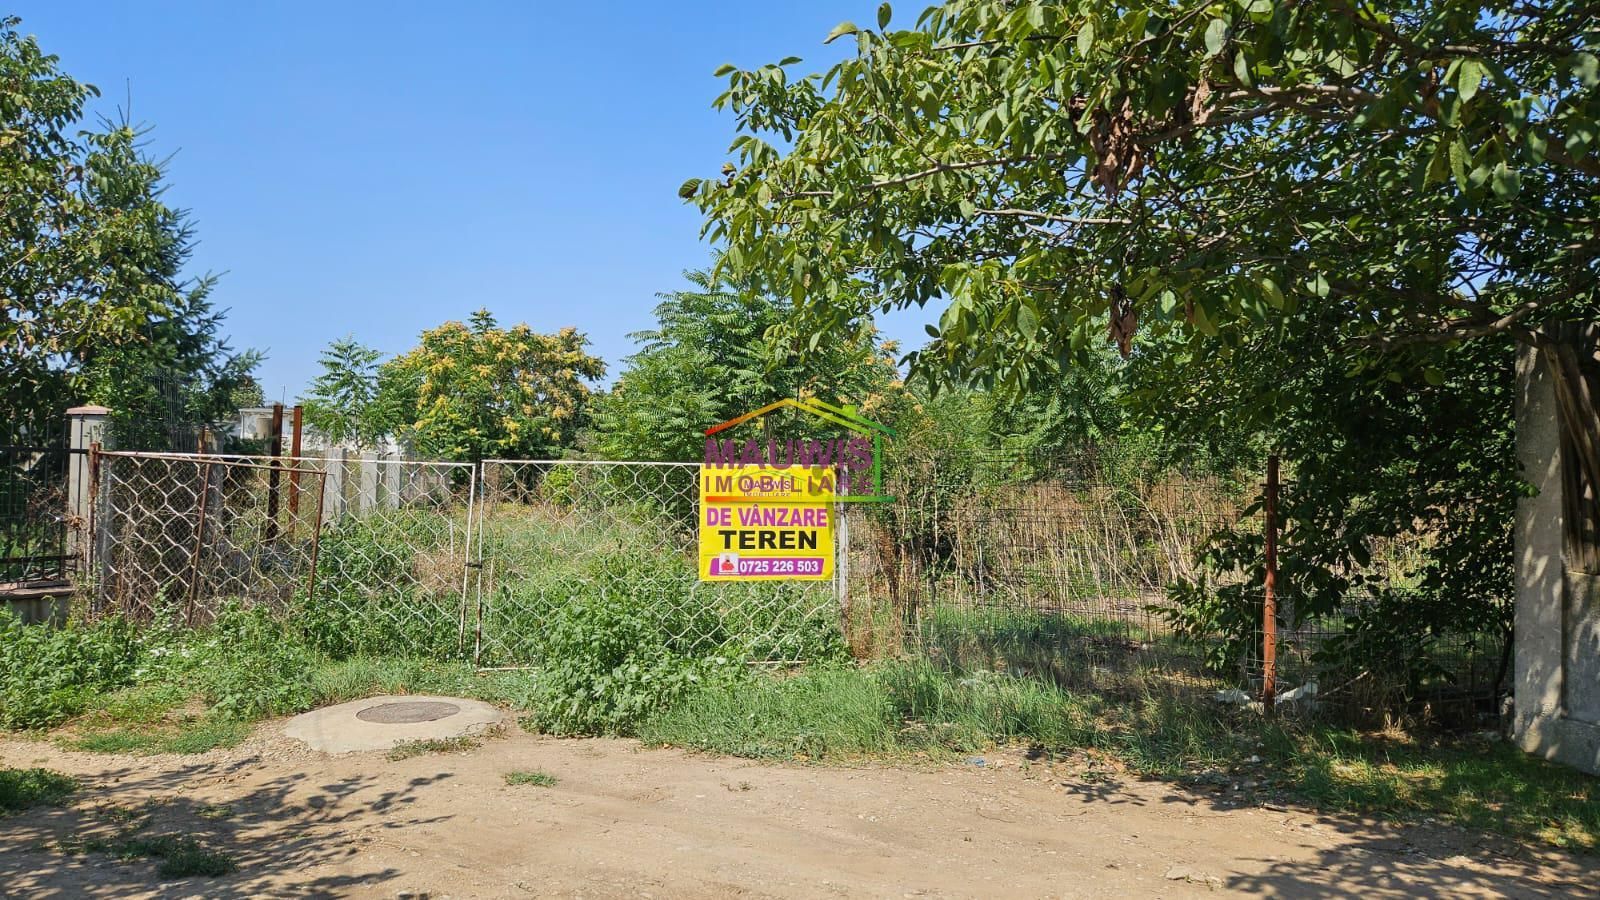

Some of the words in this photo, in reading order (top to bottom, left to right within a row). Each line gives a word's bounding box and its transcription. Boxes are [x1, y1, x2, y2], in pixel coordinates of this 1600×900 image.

[706, 507, 732, 526] DE
[738, 503, 828, 527] VÂNZARE
[718, 530, 817, 549] TEREN
[739, 561, 769, 572] 0725
[772, 561, 794, 572] 226
[797, 560, 819, 572] 503
